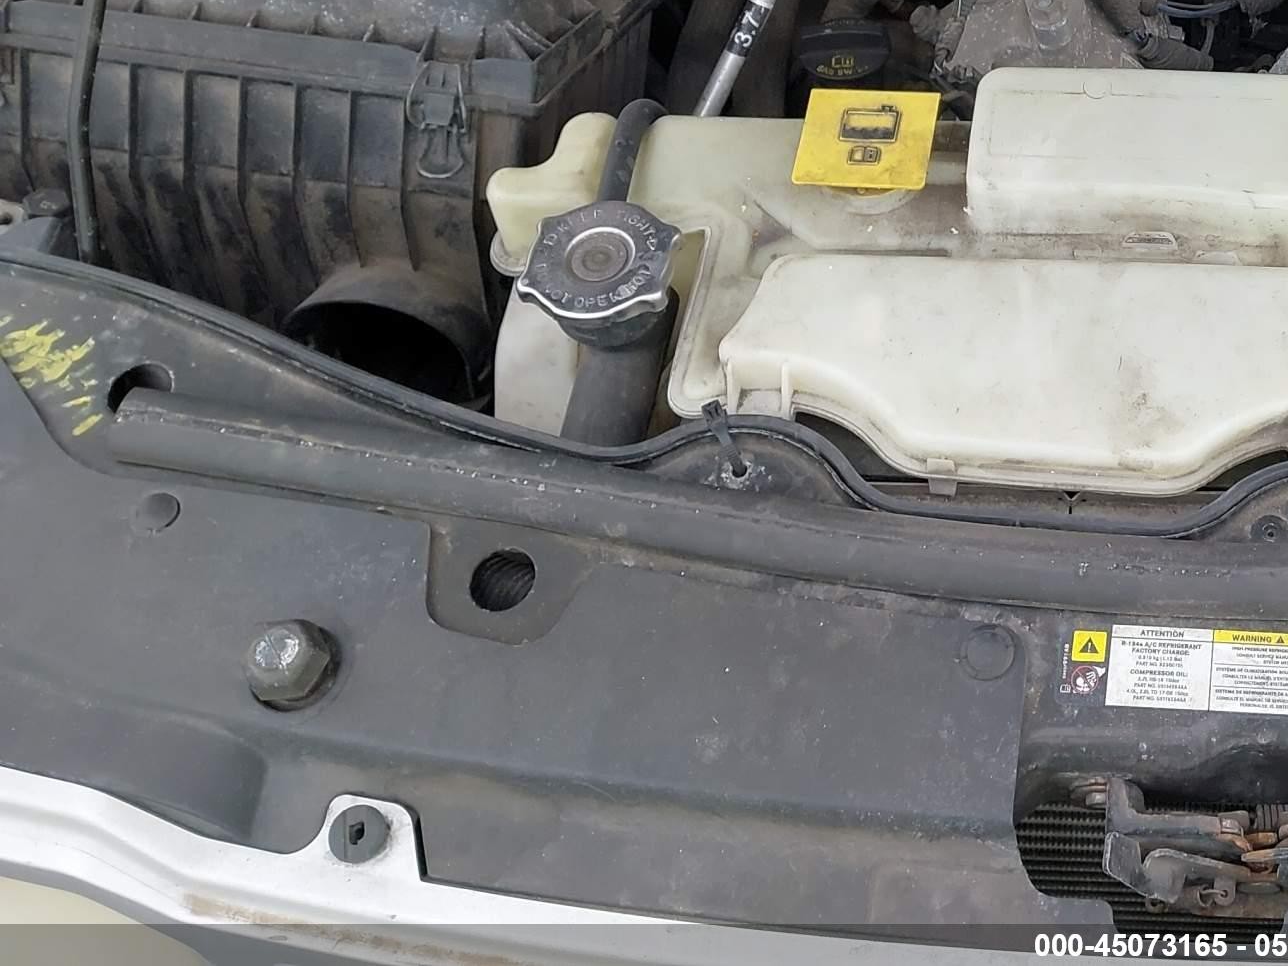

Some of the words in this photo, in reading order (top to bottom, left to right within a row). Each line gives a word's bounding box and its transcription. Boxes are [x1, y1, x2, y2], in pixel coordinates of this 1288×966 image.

[1140, 629, 1185, 638] ATTENTION
[1232, 634, 1272, 643] WARNING
[1158, 642, 1202, 650] REFRIGERANT
[1130, 668, 1175, 677] COMPRESSOR
